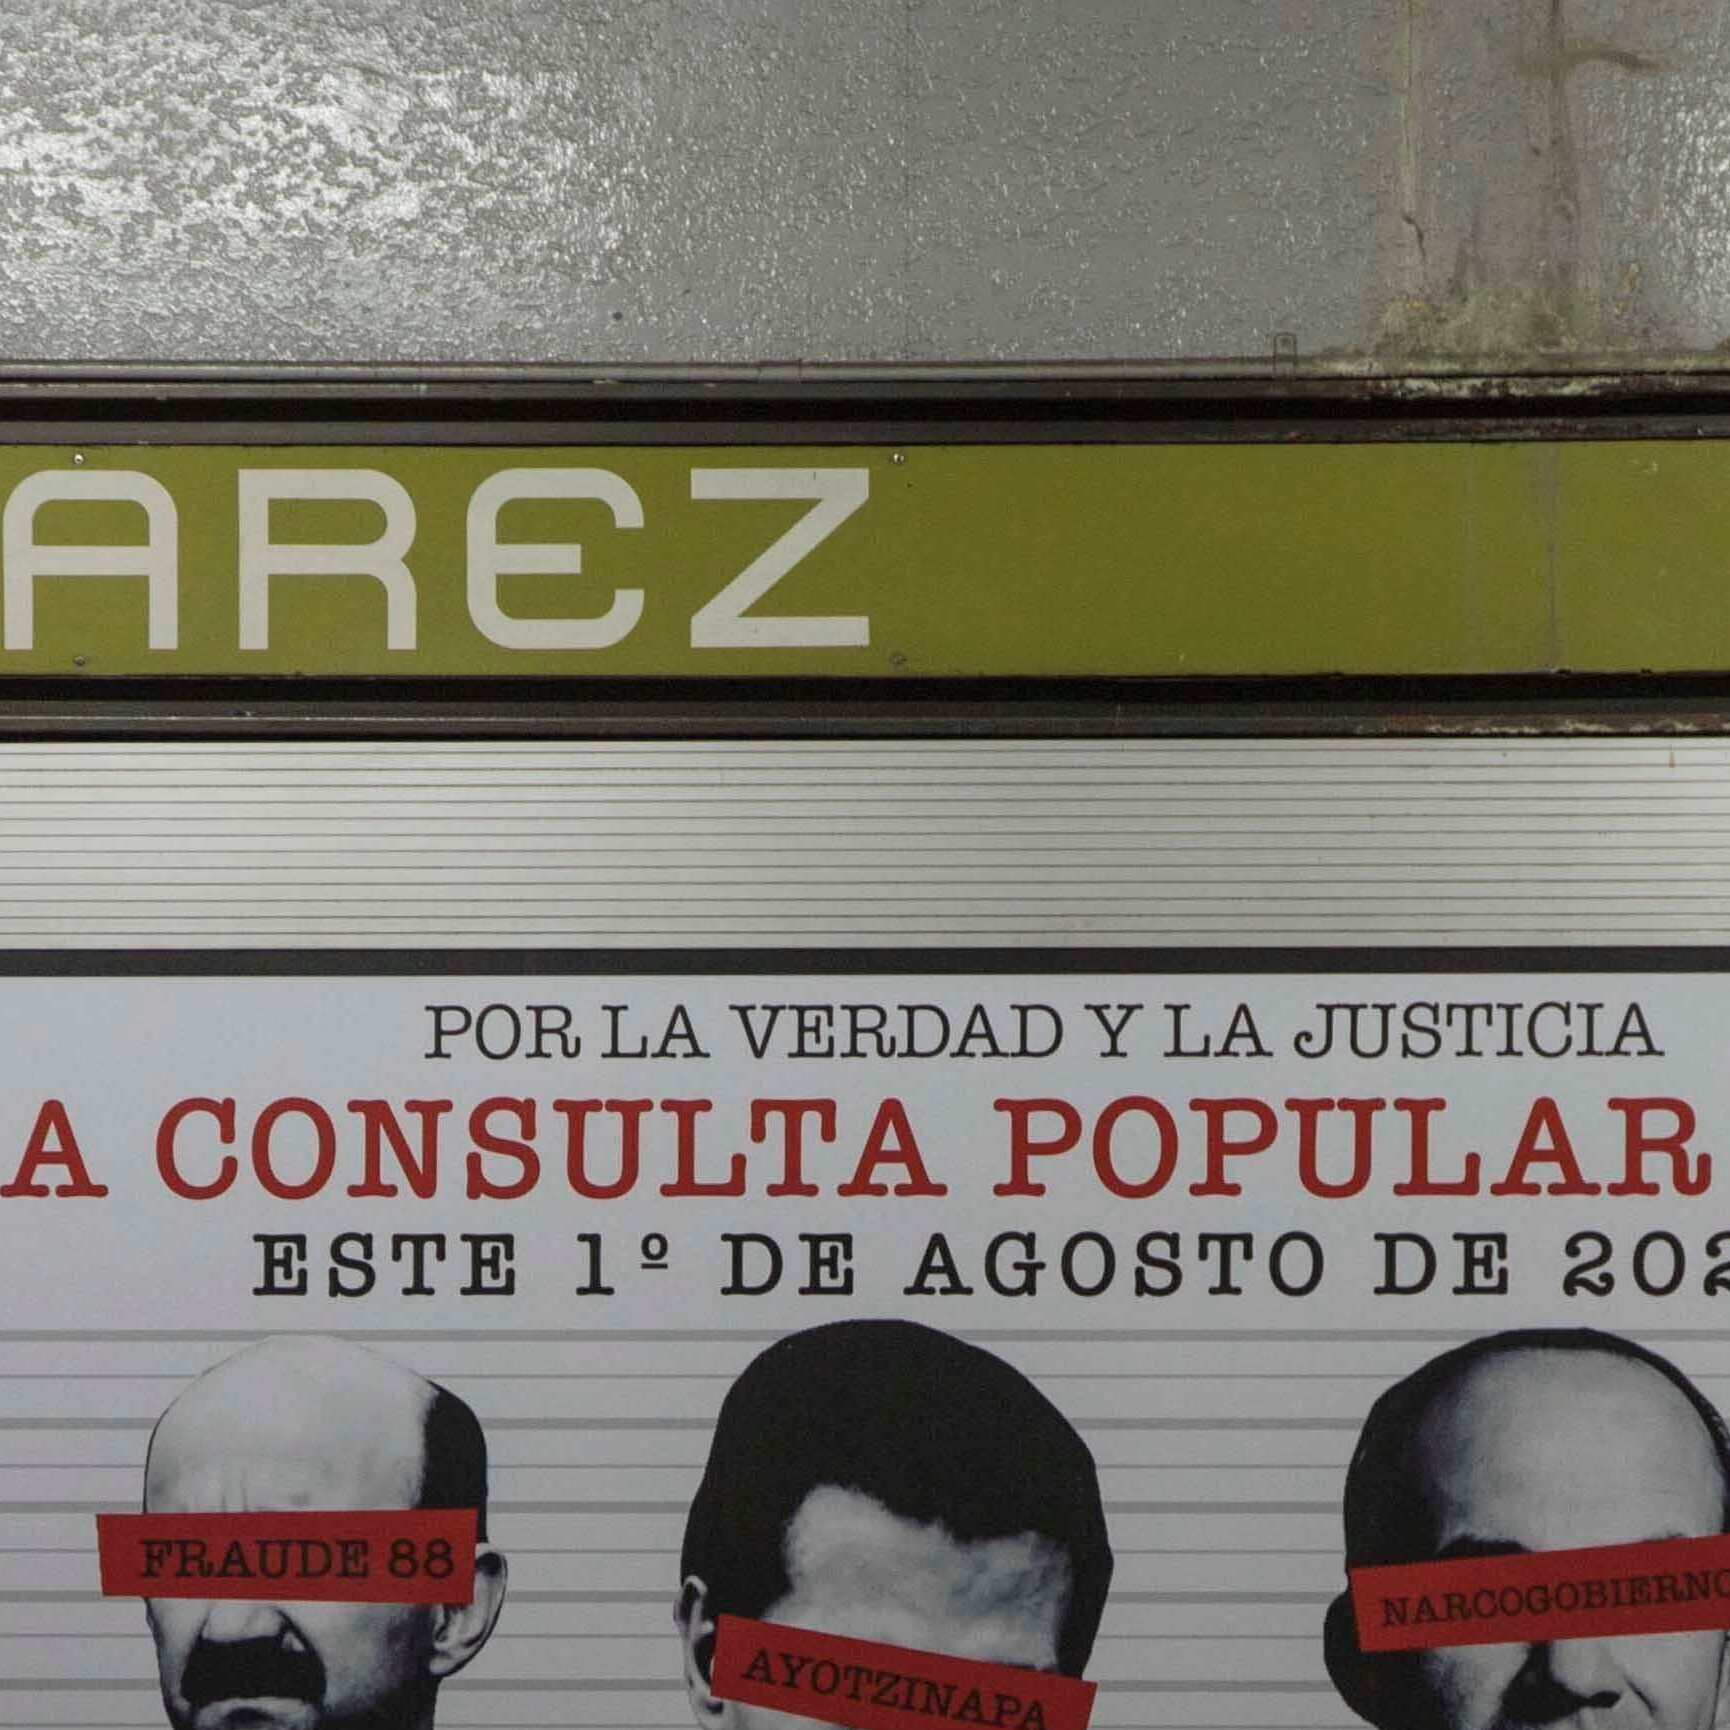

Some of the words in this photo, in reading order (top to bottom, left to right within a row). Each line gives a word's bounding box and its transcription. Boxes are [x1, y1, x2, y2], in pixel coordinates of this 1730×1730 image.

[425, 1004, 580, 1060] POR
[601, 1005, 710, 1058] LA
[729, 1004, 1063, 1058] VERDAD
[1085, 1004, 1143, 1057] Y
[1164, 1003, 1273, 1057] LA
[1294, 1002, 1664, 1058] JUSTICIA
[155, 1096, 948, 1200] CONSULTA
[993, 1093, 1713, 1199] POPULAR
[253, 1232, 515, 1297] ESTE
[721, 1233, 853, 1296] DE
[903, 1231, 1323, 1297] AGOSTO
[1374, 1232, 1508, 1295] DE
[139, 1537, 371, 1581] FRAUDE
[387, 1536, 456, 1579] 88
